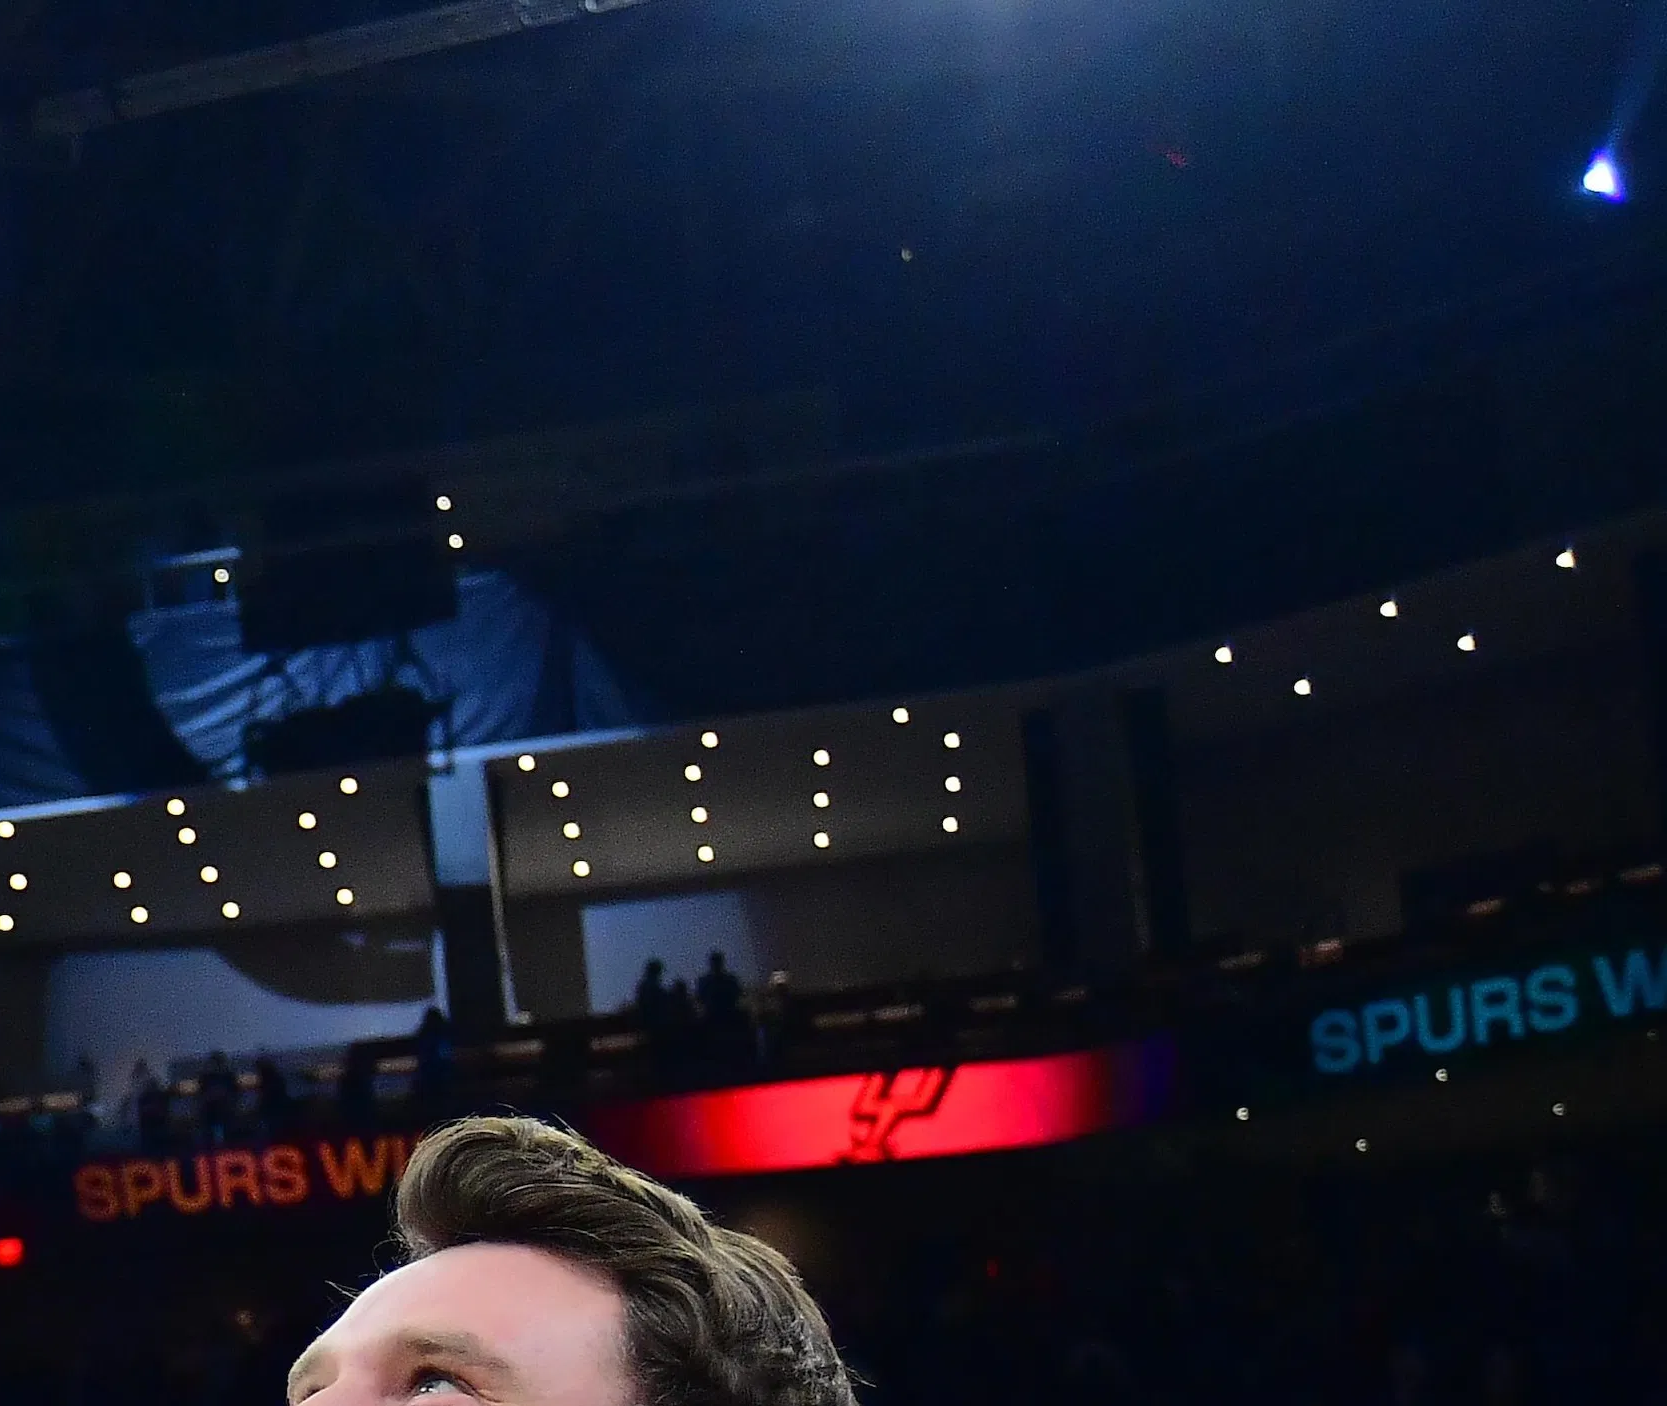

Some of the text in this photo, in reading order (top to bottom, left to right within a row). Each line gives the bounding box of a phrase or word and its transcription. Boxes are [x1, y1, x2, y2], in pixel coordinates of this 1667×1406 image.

[1311, 961, 1579, 1075] SPURS
[73, 1134, 423, 1222] SPURS WI
